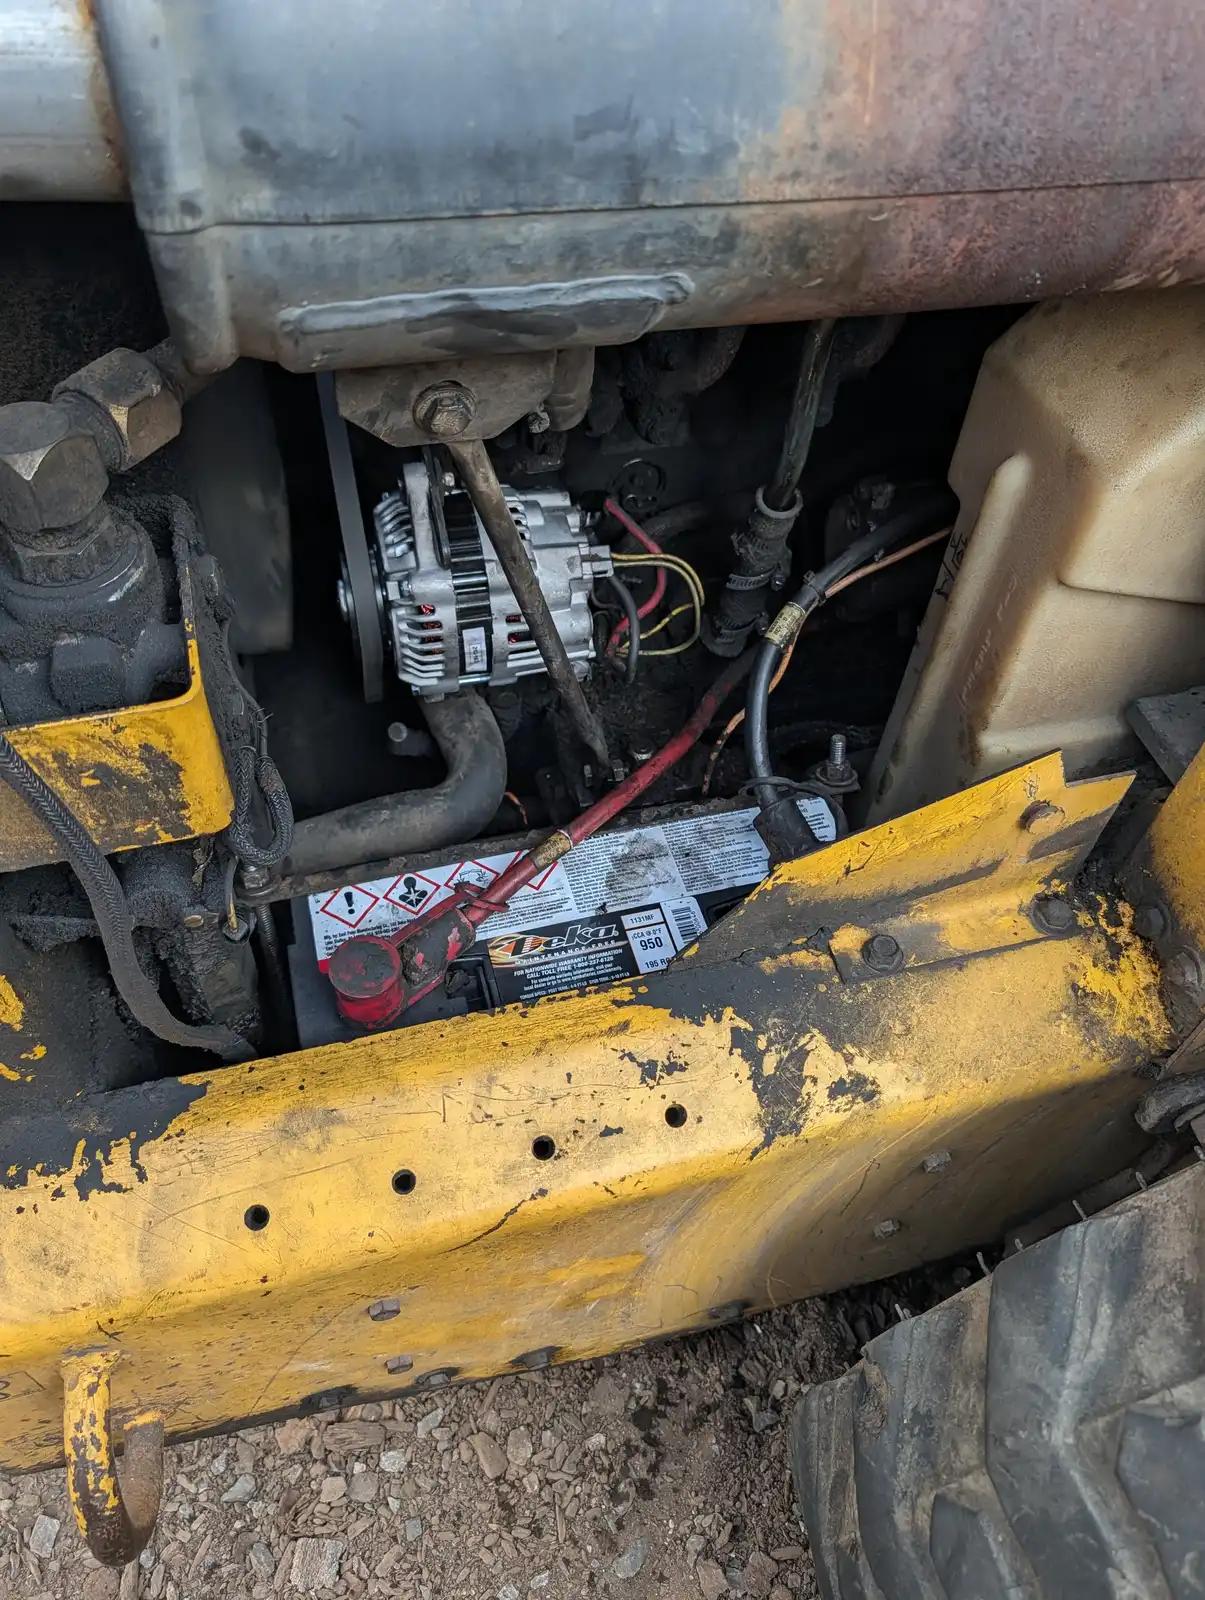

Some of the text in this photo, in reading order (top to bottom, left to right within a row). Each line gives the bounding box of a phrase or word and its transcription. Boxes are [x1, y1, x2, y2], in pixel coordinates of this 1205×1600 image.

[630, 913, 655, 924] 1131MF
[499, 924, 617, 959] Deka
[639, 936, 664, 951] 950
[645, 959, 659, 969] 195
